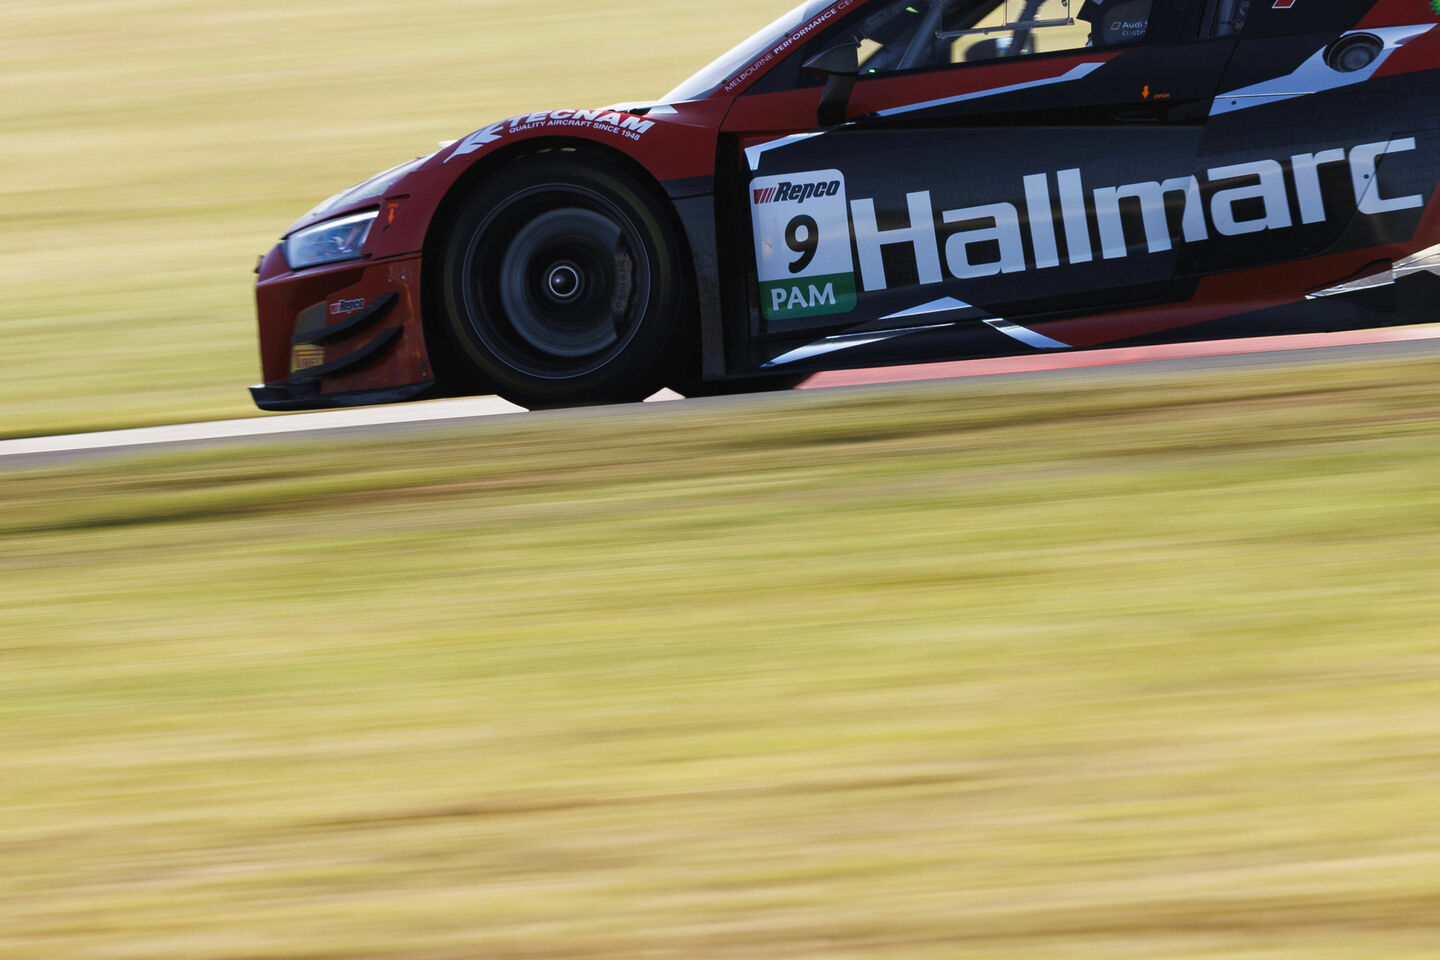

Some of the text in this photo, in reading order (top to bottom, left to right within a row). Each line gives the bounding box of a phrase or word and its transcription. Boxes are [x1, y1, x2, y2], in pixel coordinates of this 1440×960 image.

[724, 53, 773, 92] MELBOURNE
[773, 8, 837, 55] PERFORMANCE
[509, 109, 656, 135] TECNAM
[509, 119, 641, 141] QUALITY AIRCRAFT SINCE 1948
[773, 180, 841, 204] Repco
[850, 136, 1424, 292] Hallmarc
[785, 214, 819, 274] 9
[770, 282, 836, 311] PAM
